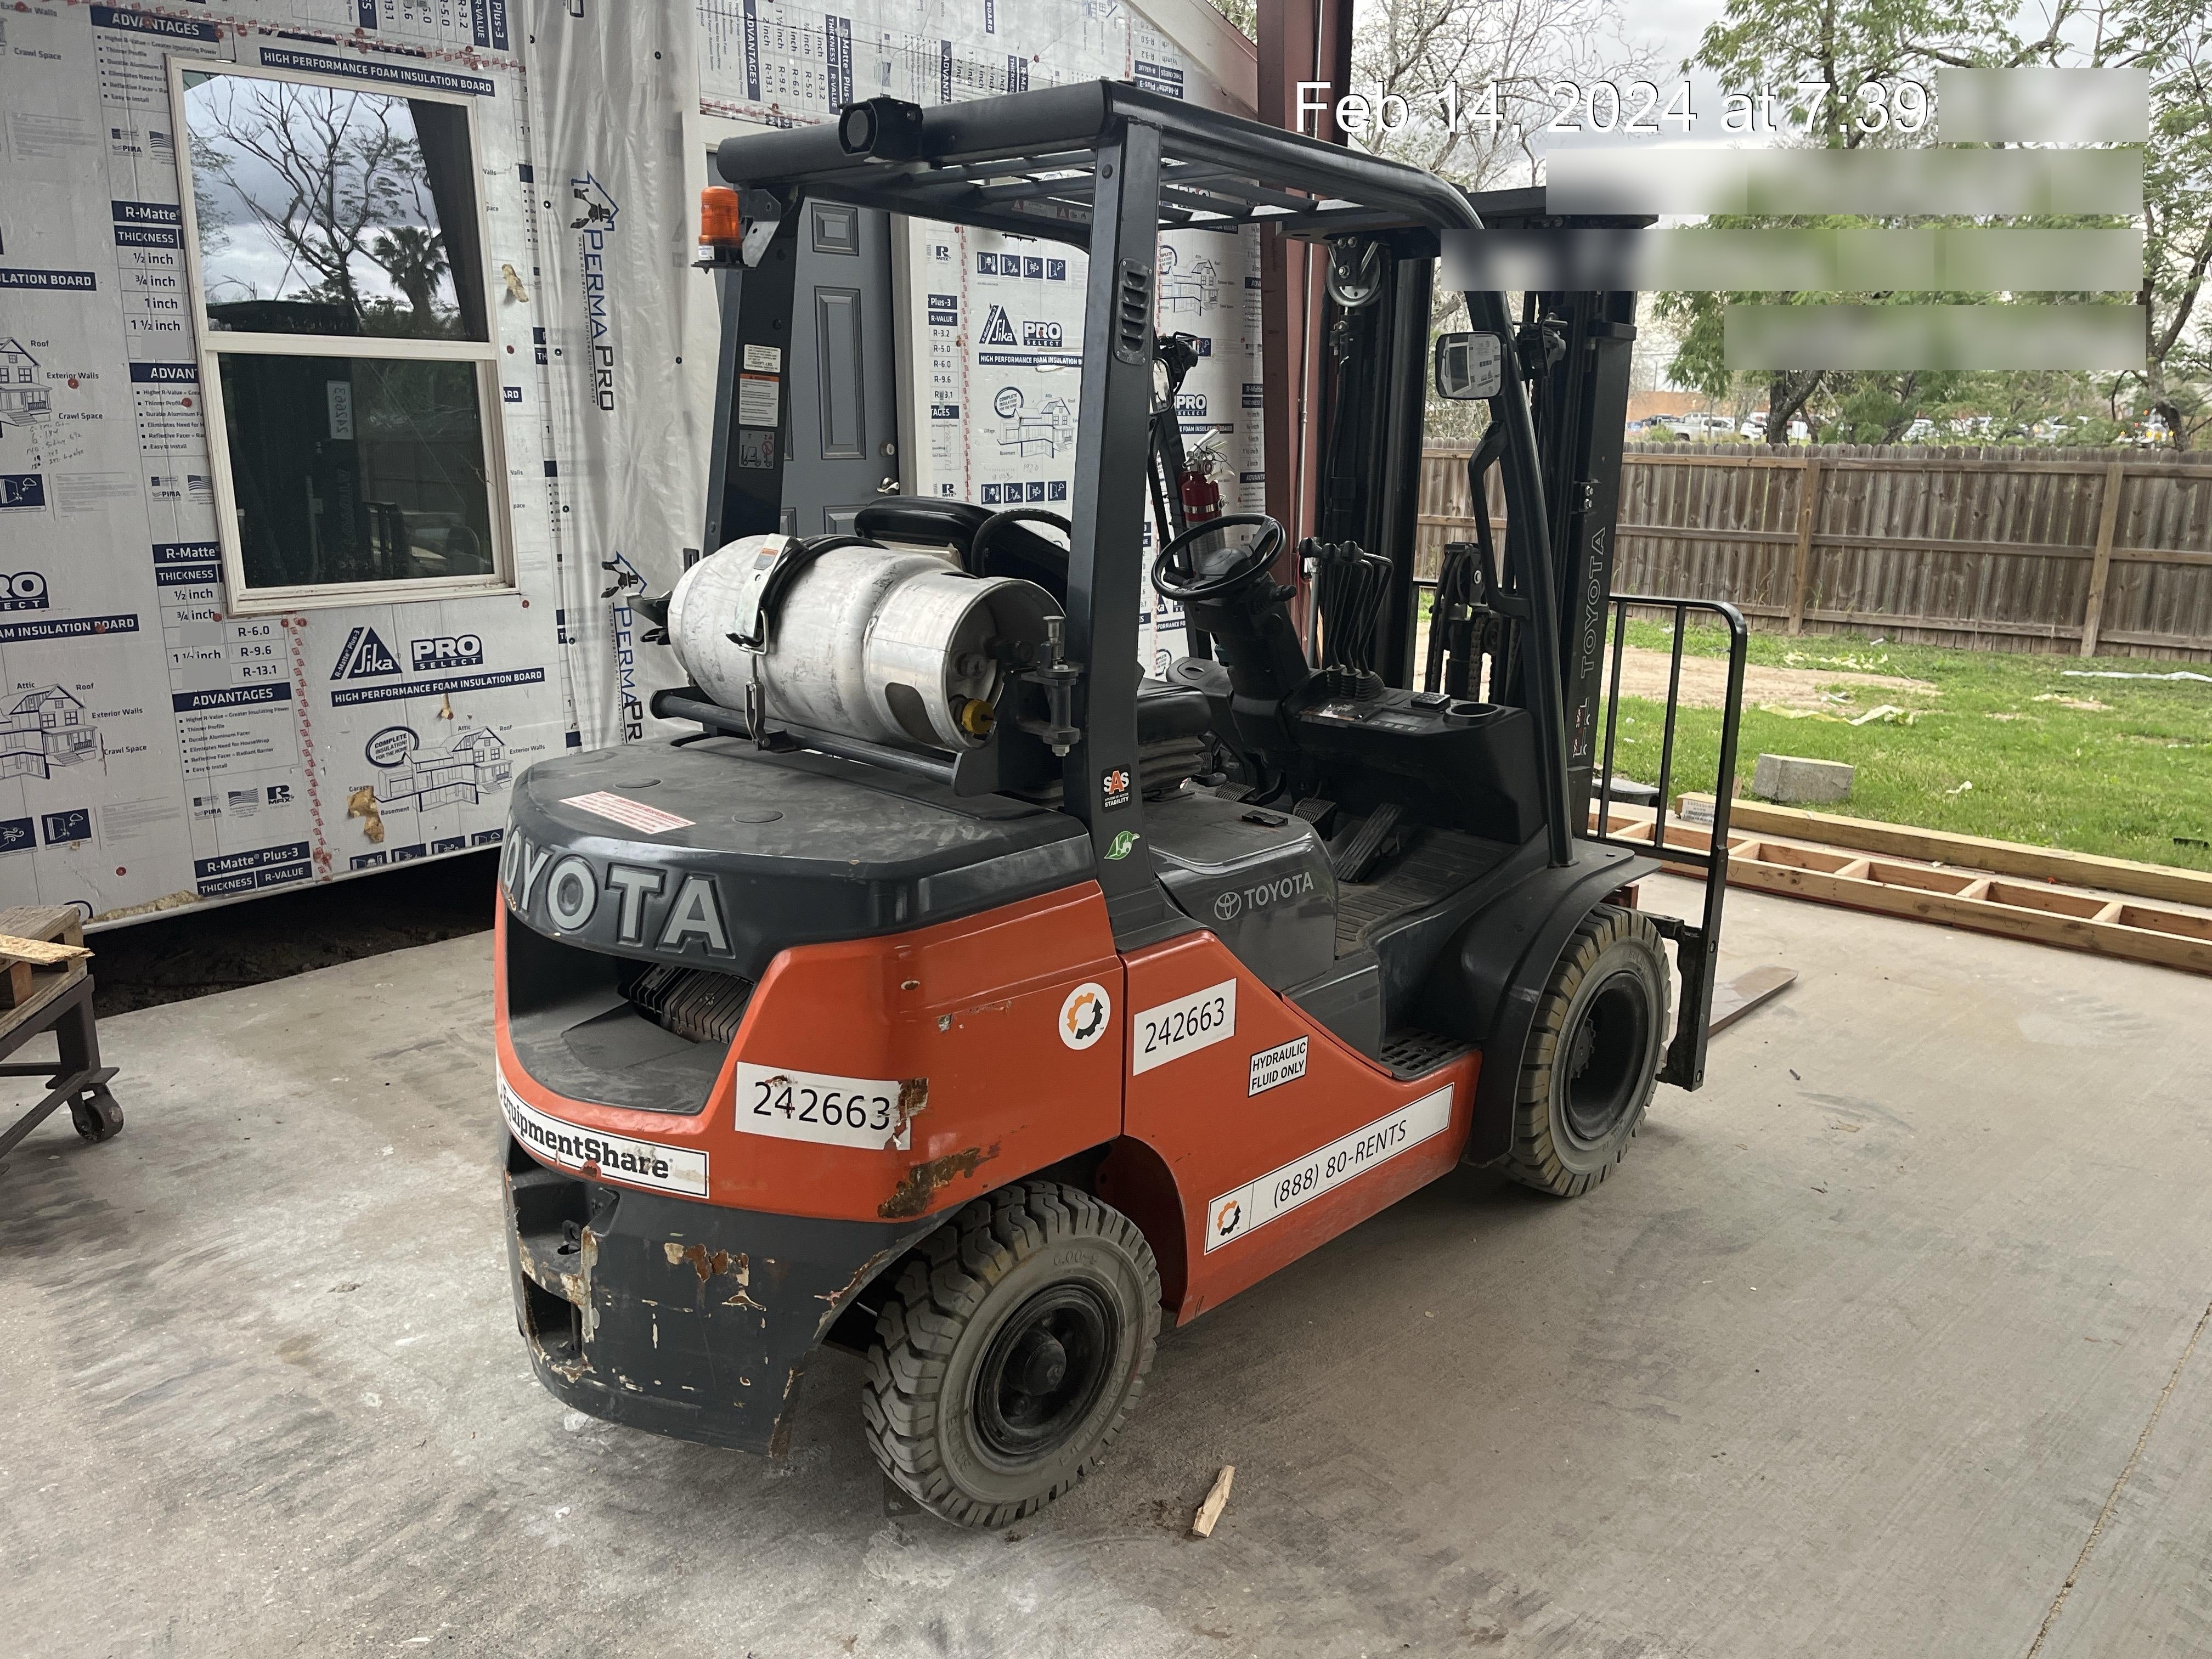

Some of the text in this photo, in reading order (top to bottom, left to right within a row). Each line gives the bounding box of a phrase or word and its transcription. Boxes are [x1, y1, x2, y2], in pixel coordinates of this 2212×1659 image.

[35, 7, 57, 16] Walls
[493, 2, 504, 38] Plus-3
[1141, 36, 1154, 46] R-5.0
[14, 48, 61, 60] Crawl Space
[746, 12, 757, 85] ADVANTAGES
[1141, 50, 1154, 60] R-3.2
[264, 52, 492, 92] HIGH PERFORMANCE FOAM INSULATION BOARD
[118, 231, 174, 243] THICKNESS
[149, 253, 173, 264] inch
[50, 275, 92, 286] BOARD
[151, 275, 176, 286] inch
[145, 297, 178, 309] 1 inch
[930, 298, 951, 307] Plus-3
[931, 315, 953, 323] R-VALUE
[989, 306, 997, 321] Plus-3
[131, 320, 180, 331] 1 inch
[583, 229, 614, 411] PERMA PRO
[992, 319, 1013, 342] Sika
[1024, 323, 1062, 340] PRO
[995, 356, 1032, 364] PERFORMANCE
[1048, 357, 1077, 365] INSULATION
[151, 368, 198, 379] ADVAN
[934, 375, 951, 383] R-9.6
[1177, 394, 1206, 410] PRO
[81, 413, 103, 421] Space
[159, 570, 213, 581] THICKNESS
[189, 588, 213, 599] inch
[1581, 526, 1606, 679] TOYOTA
[191, 608, 215, 620] inch
[18, 622, 91, 637] INSULATION
[238, 625, 270, 637] R-6.0
[347, 629, 360, 650] Plus-3
[240, 645, 272, 657] R-9.6
[413, 635, 481, 661] PRO
[354, 644, 394, 674] Sika
[420, 657, 477, 670] SELECT
[613, 607, 637, 709] PERMA
[242, 665, 276, 677] R-13.1
[76, 682, 94, 691] Roof
[335, 671, 543, 703] HIGH PERFORMANCE FOAM INSULATION BOARD
[193, 687, 274, 707] ADVANTAGES
[92, 707, 143, 719] Exterior Walls
[240, 738, 270, 747] HouseWrap
[374, 733, 408, 749] COMPLETE
[103, 745, 147, 755] Crawl Space
[395, 746, 408, 756] HOME
[509, 747, 529, 755] Exterior
[1103, 770, 1130, 795] SAS
[268, 797, 291, 805] MAX
[1104, 796, 1129, 808] STABILITY
[381, 806, 410, 816] Basement
[263, 847, 299, 862] Plus-3
[200, 867, 304, 894] THICKNESS R-VALUE
[504, 828, 728, 951] OYOTA
[1244, 871, 1314, 910] TOYOTA
[1144, 996, 1225, 1055] 242663
[1252, 1042, 1307, 1072] HYDRAULIC
[1251, 1059, 1305, 1090] FLUID ONLY
[753, 1081, 891, 1131] 242663
[1273, 1119, 1407, 1209] (888) 80-RENTS
